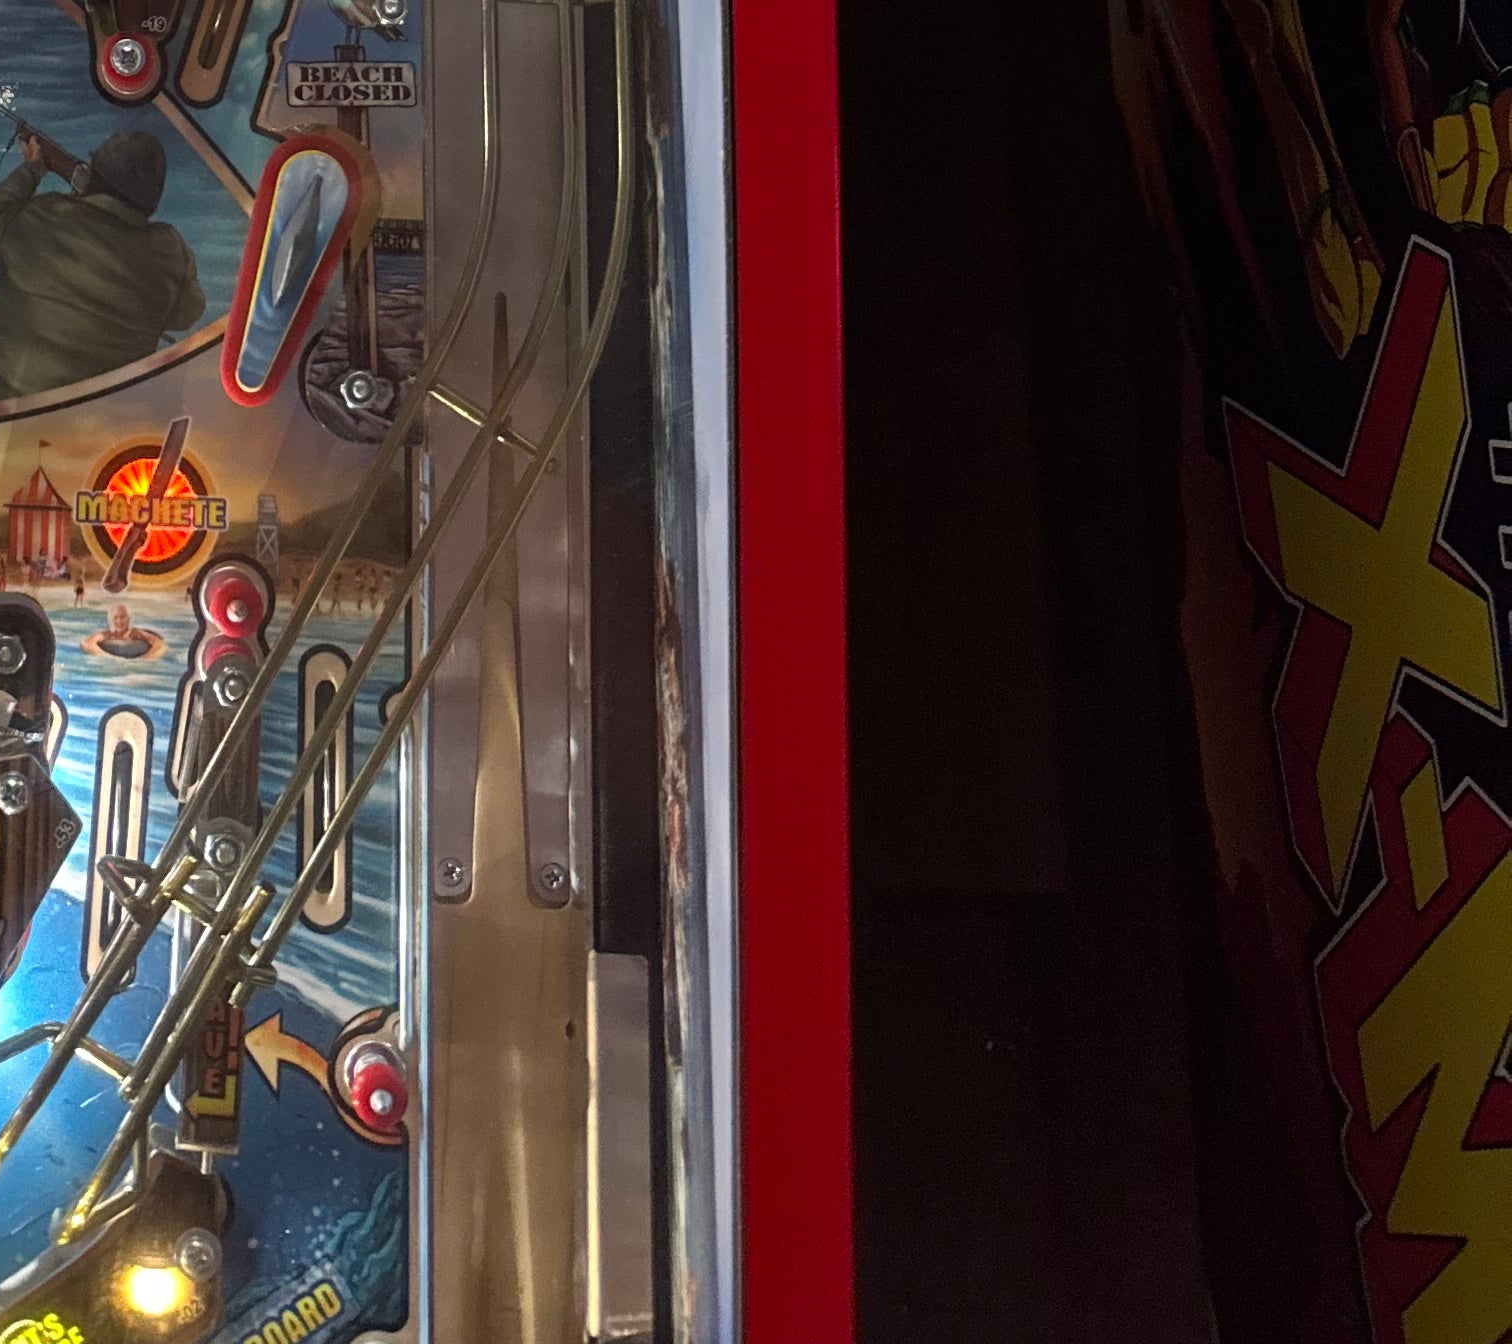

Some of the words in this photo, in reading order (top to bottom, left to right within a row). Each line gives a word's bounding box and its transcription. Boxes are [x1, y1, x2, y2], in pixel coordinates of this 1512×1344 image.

[299, 66, 404, 83] BEACH
[293, 83, 413, 102] CLOSED
[75, 490, 228, 530] MACHETE
